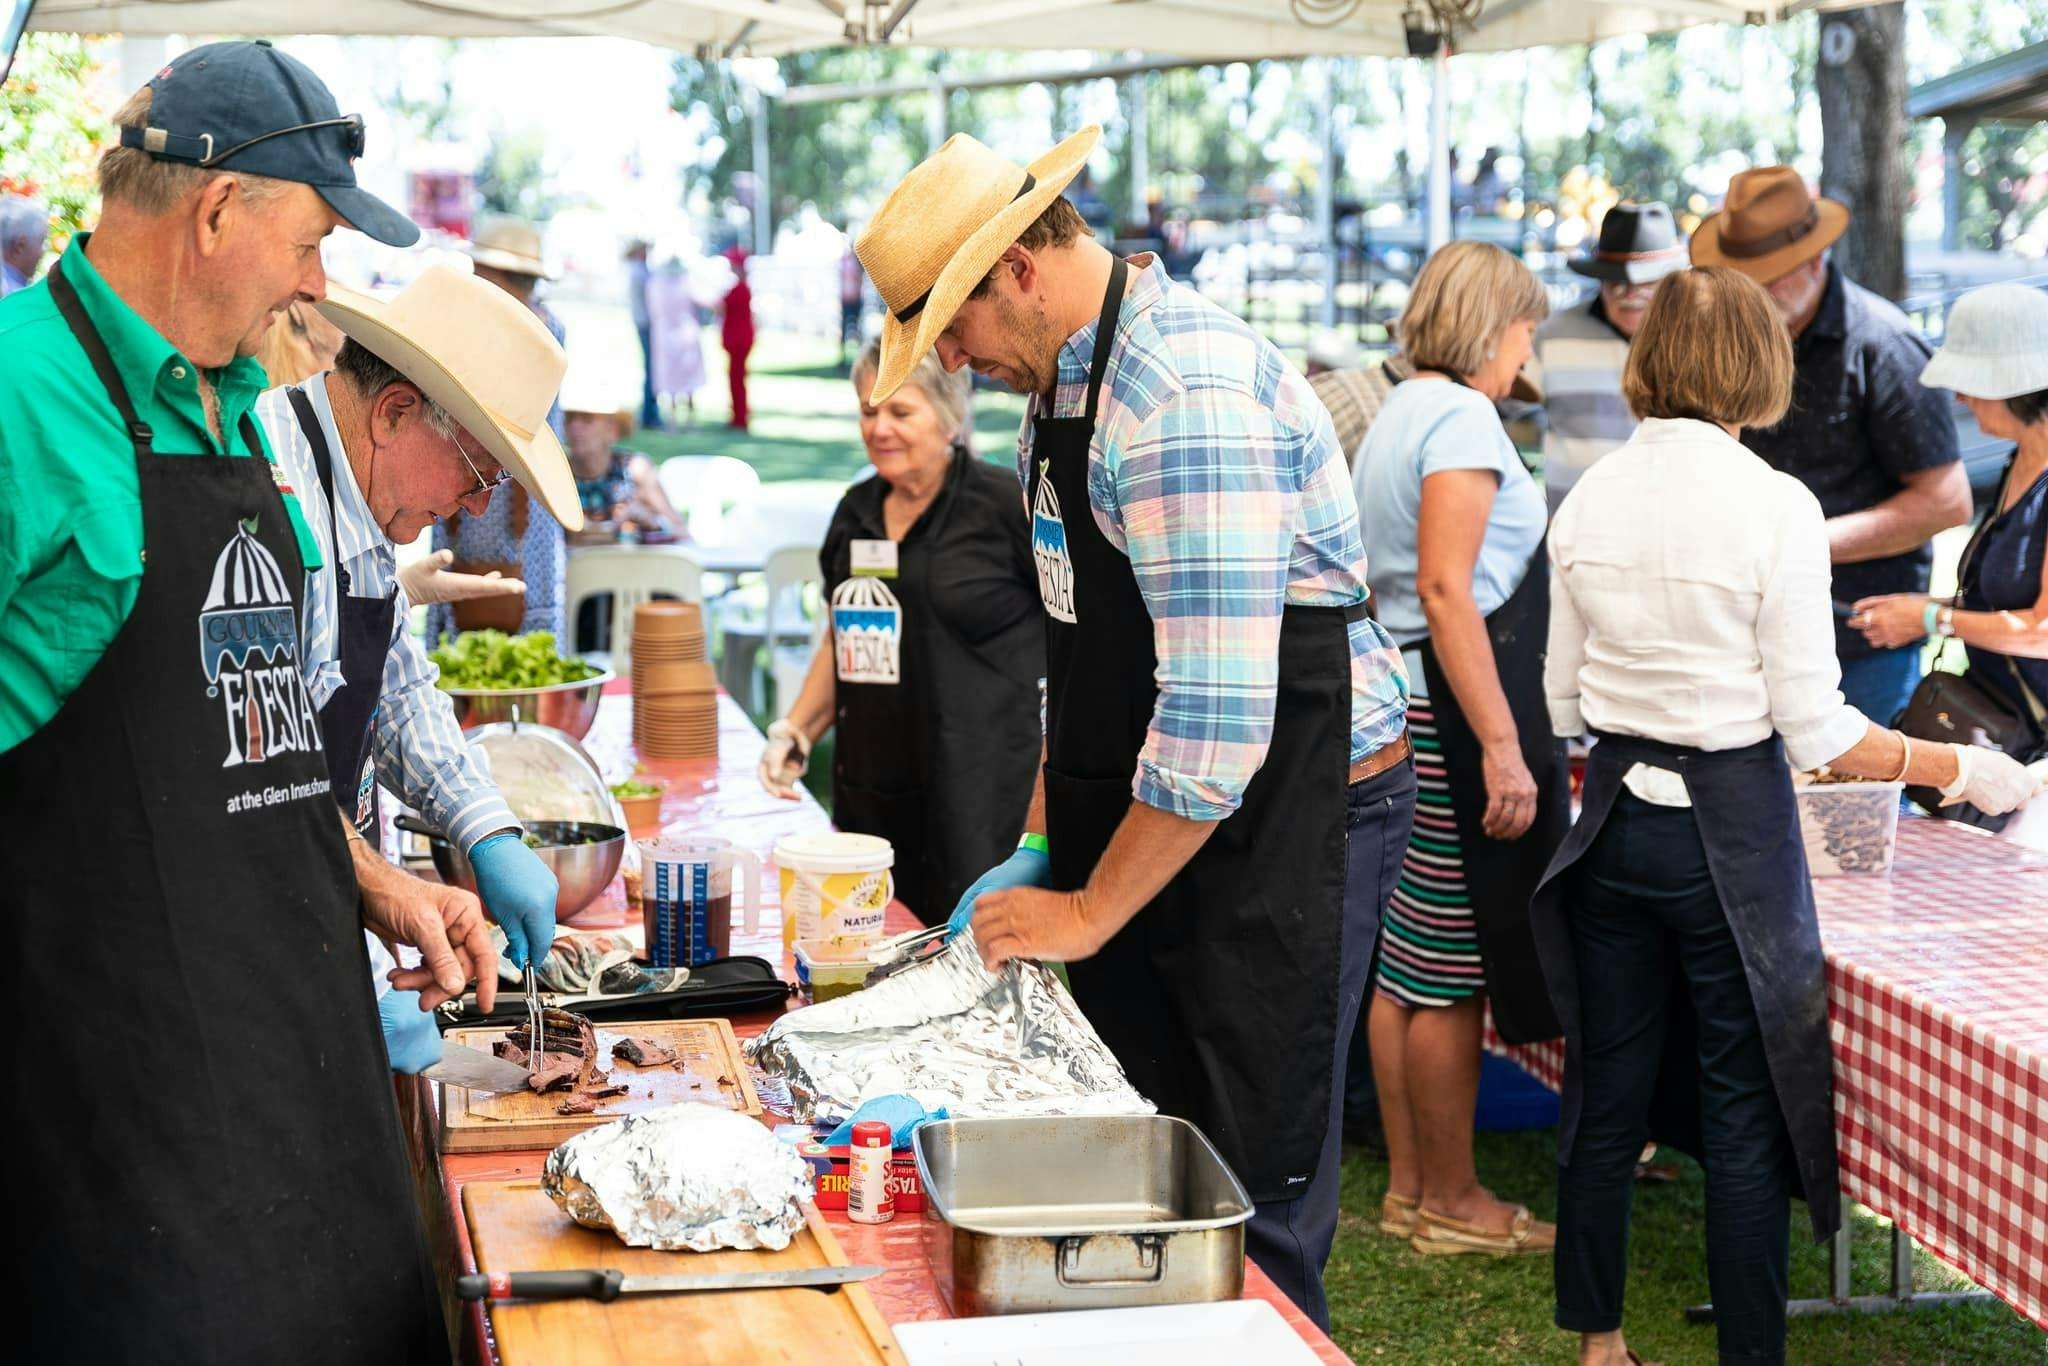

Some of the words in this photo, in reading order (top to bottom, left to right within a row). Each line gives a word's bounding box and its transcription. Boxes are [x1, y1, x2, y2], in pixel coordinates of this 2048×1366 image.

[220, 664, 322, 768] FIESTA
[227, 795, 242, 814] at
[242, 789, 263, 811] the
[263, 785, 290, 806] Glen
